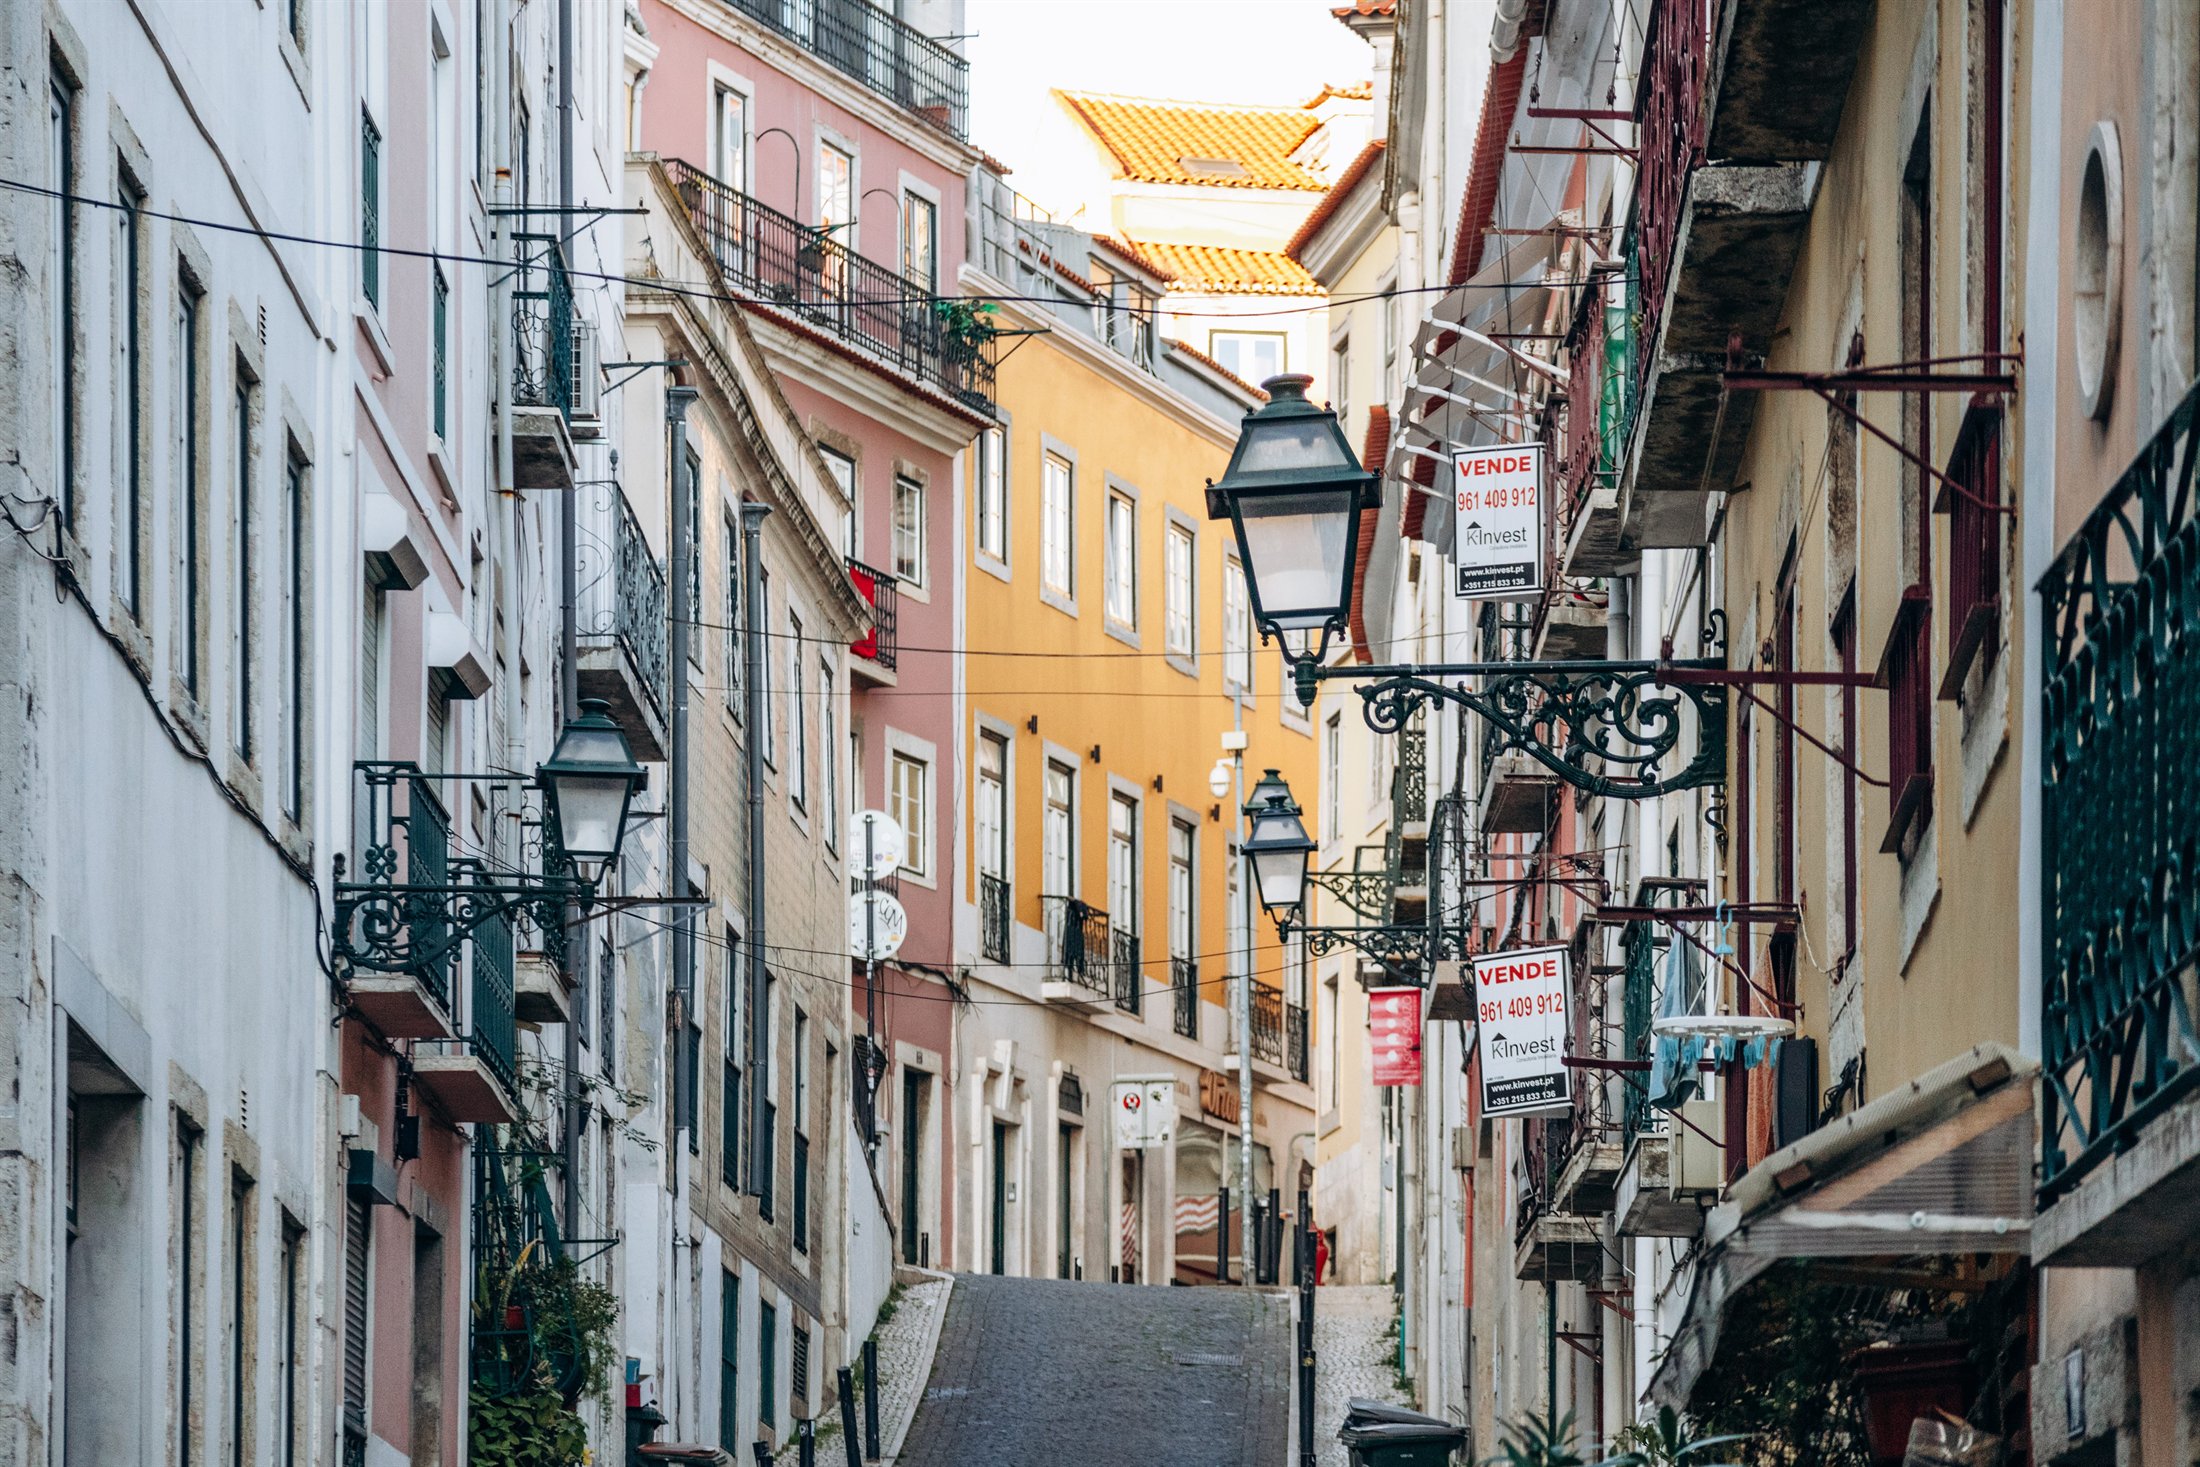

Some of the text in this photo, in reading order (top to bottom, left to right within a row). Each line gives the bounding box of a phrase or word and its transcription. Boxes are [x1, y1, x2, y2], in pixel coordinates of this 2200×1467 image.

[1459, 456, 1531, 477] VENDE
[1458, 486, 1535, 511] 961 409 912
[1464, 566, 1524, 577] www.kinvest.pt
[1464, 581, 1481, 589] +351
[1483, 580, 1497, 588] 215
[1497, 579, 1511, 587] 833
[1478, 960, 1557, 986] VENDE
[1480, 992, 1563, 1023] 961 409 912
[1491, 1076, 1554, 1092] www.kinvest.pt
[1492, 1090, 1556, 1106] +351 215 833 136
